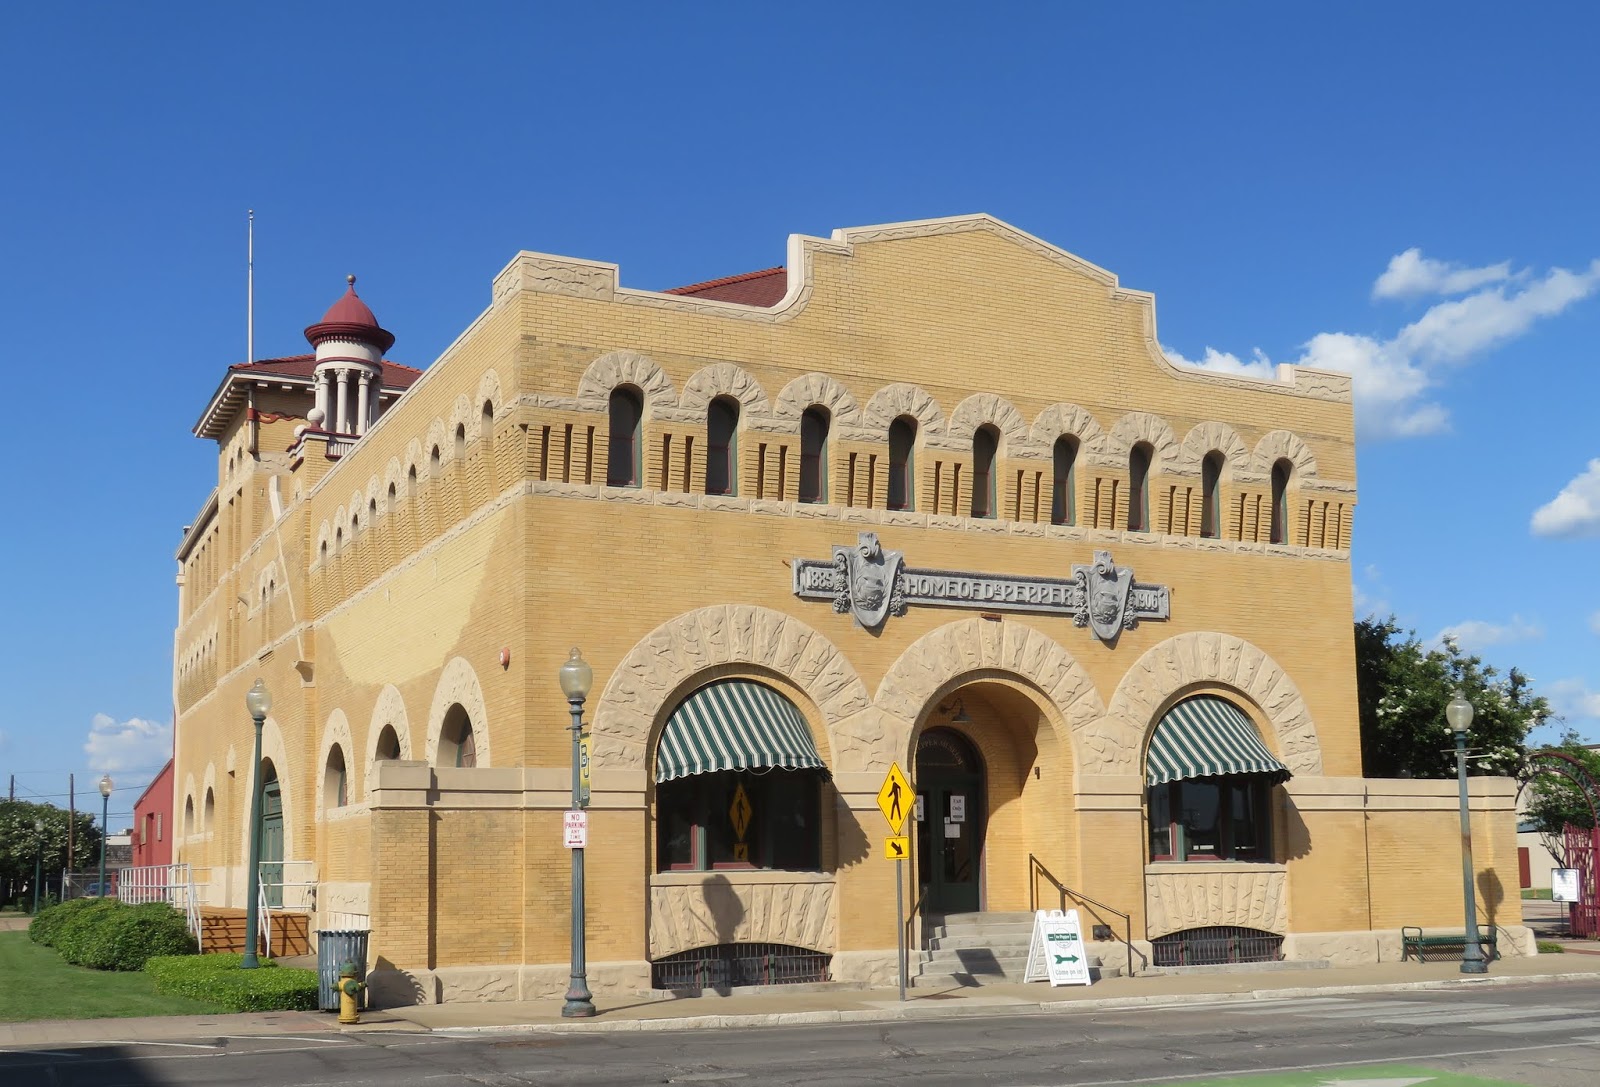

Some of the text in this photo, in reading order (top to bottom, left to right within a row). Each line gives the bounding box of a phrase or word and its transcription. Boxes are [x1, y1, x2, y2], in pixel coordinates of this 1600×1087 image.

[804, 569, 834, 590] 1885
[905, 575, 957, 597] HOME
[958, 580, 981, 600] OF
[1001, 585, 1073, 607] PEPPER
[1135, 590, 1158, 610] 1906
